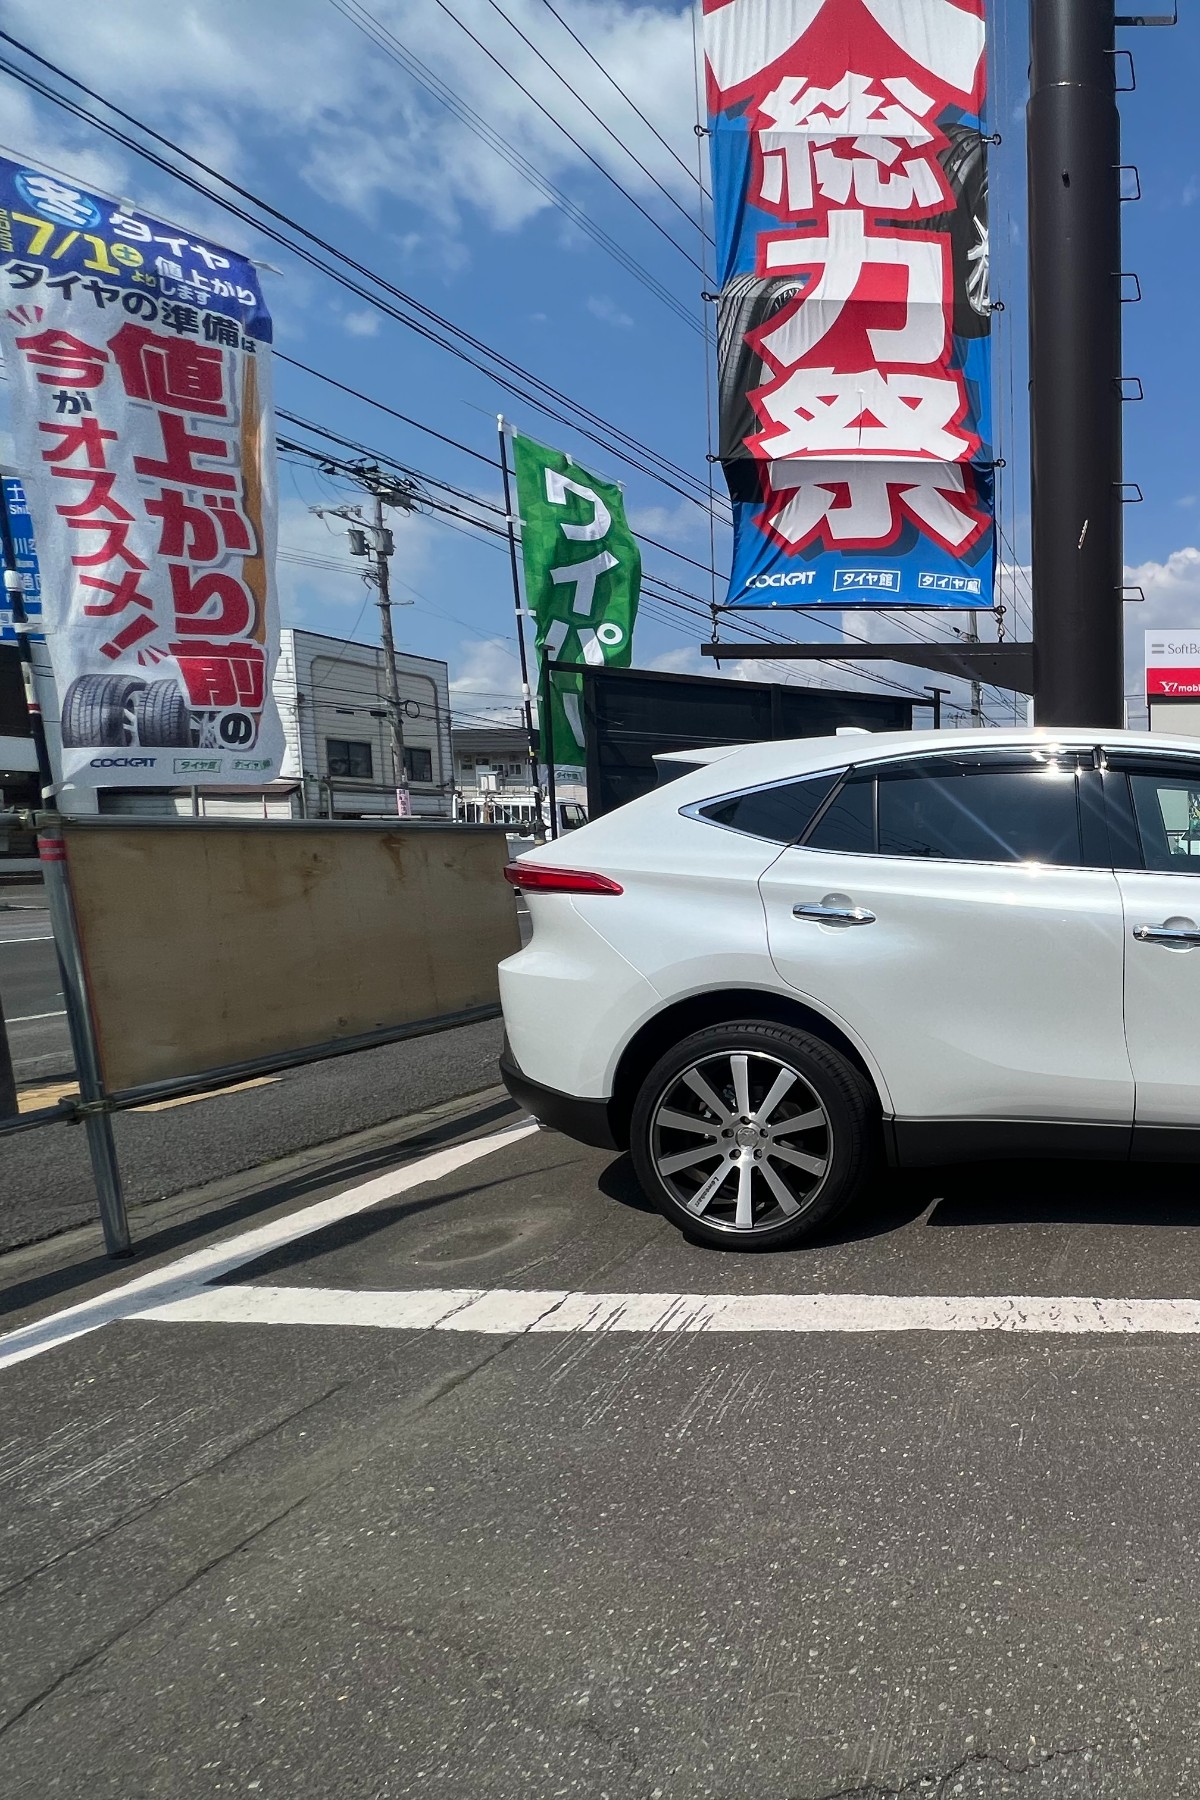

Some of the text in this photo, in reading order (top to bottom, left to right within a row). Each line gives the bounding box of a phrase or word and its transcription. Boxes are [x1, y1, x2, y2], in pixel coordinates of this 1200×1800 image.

[745, 571, 816, 588] COCKPIT
[843, 572, 893, 587] タイヤ館
[90, 758, 157, 768] COCKPIT
